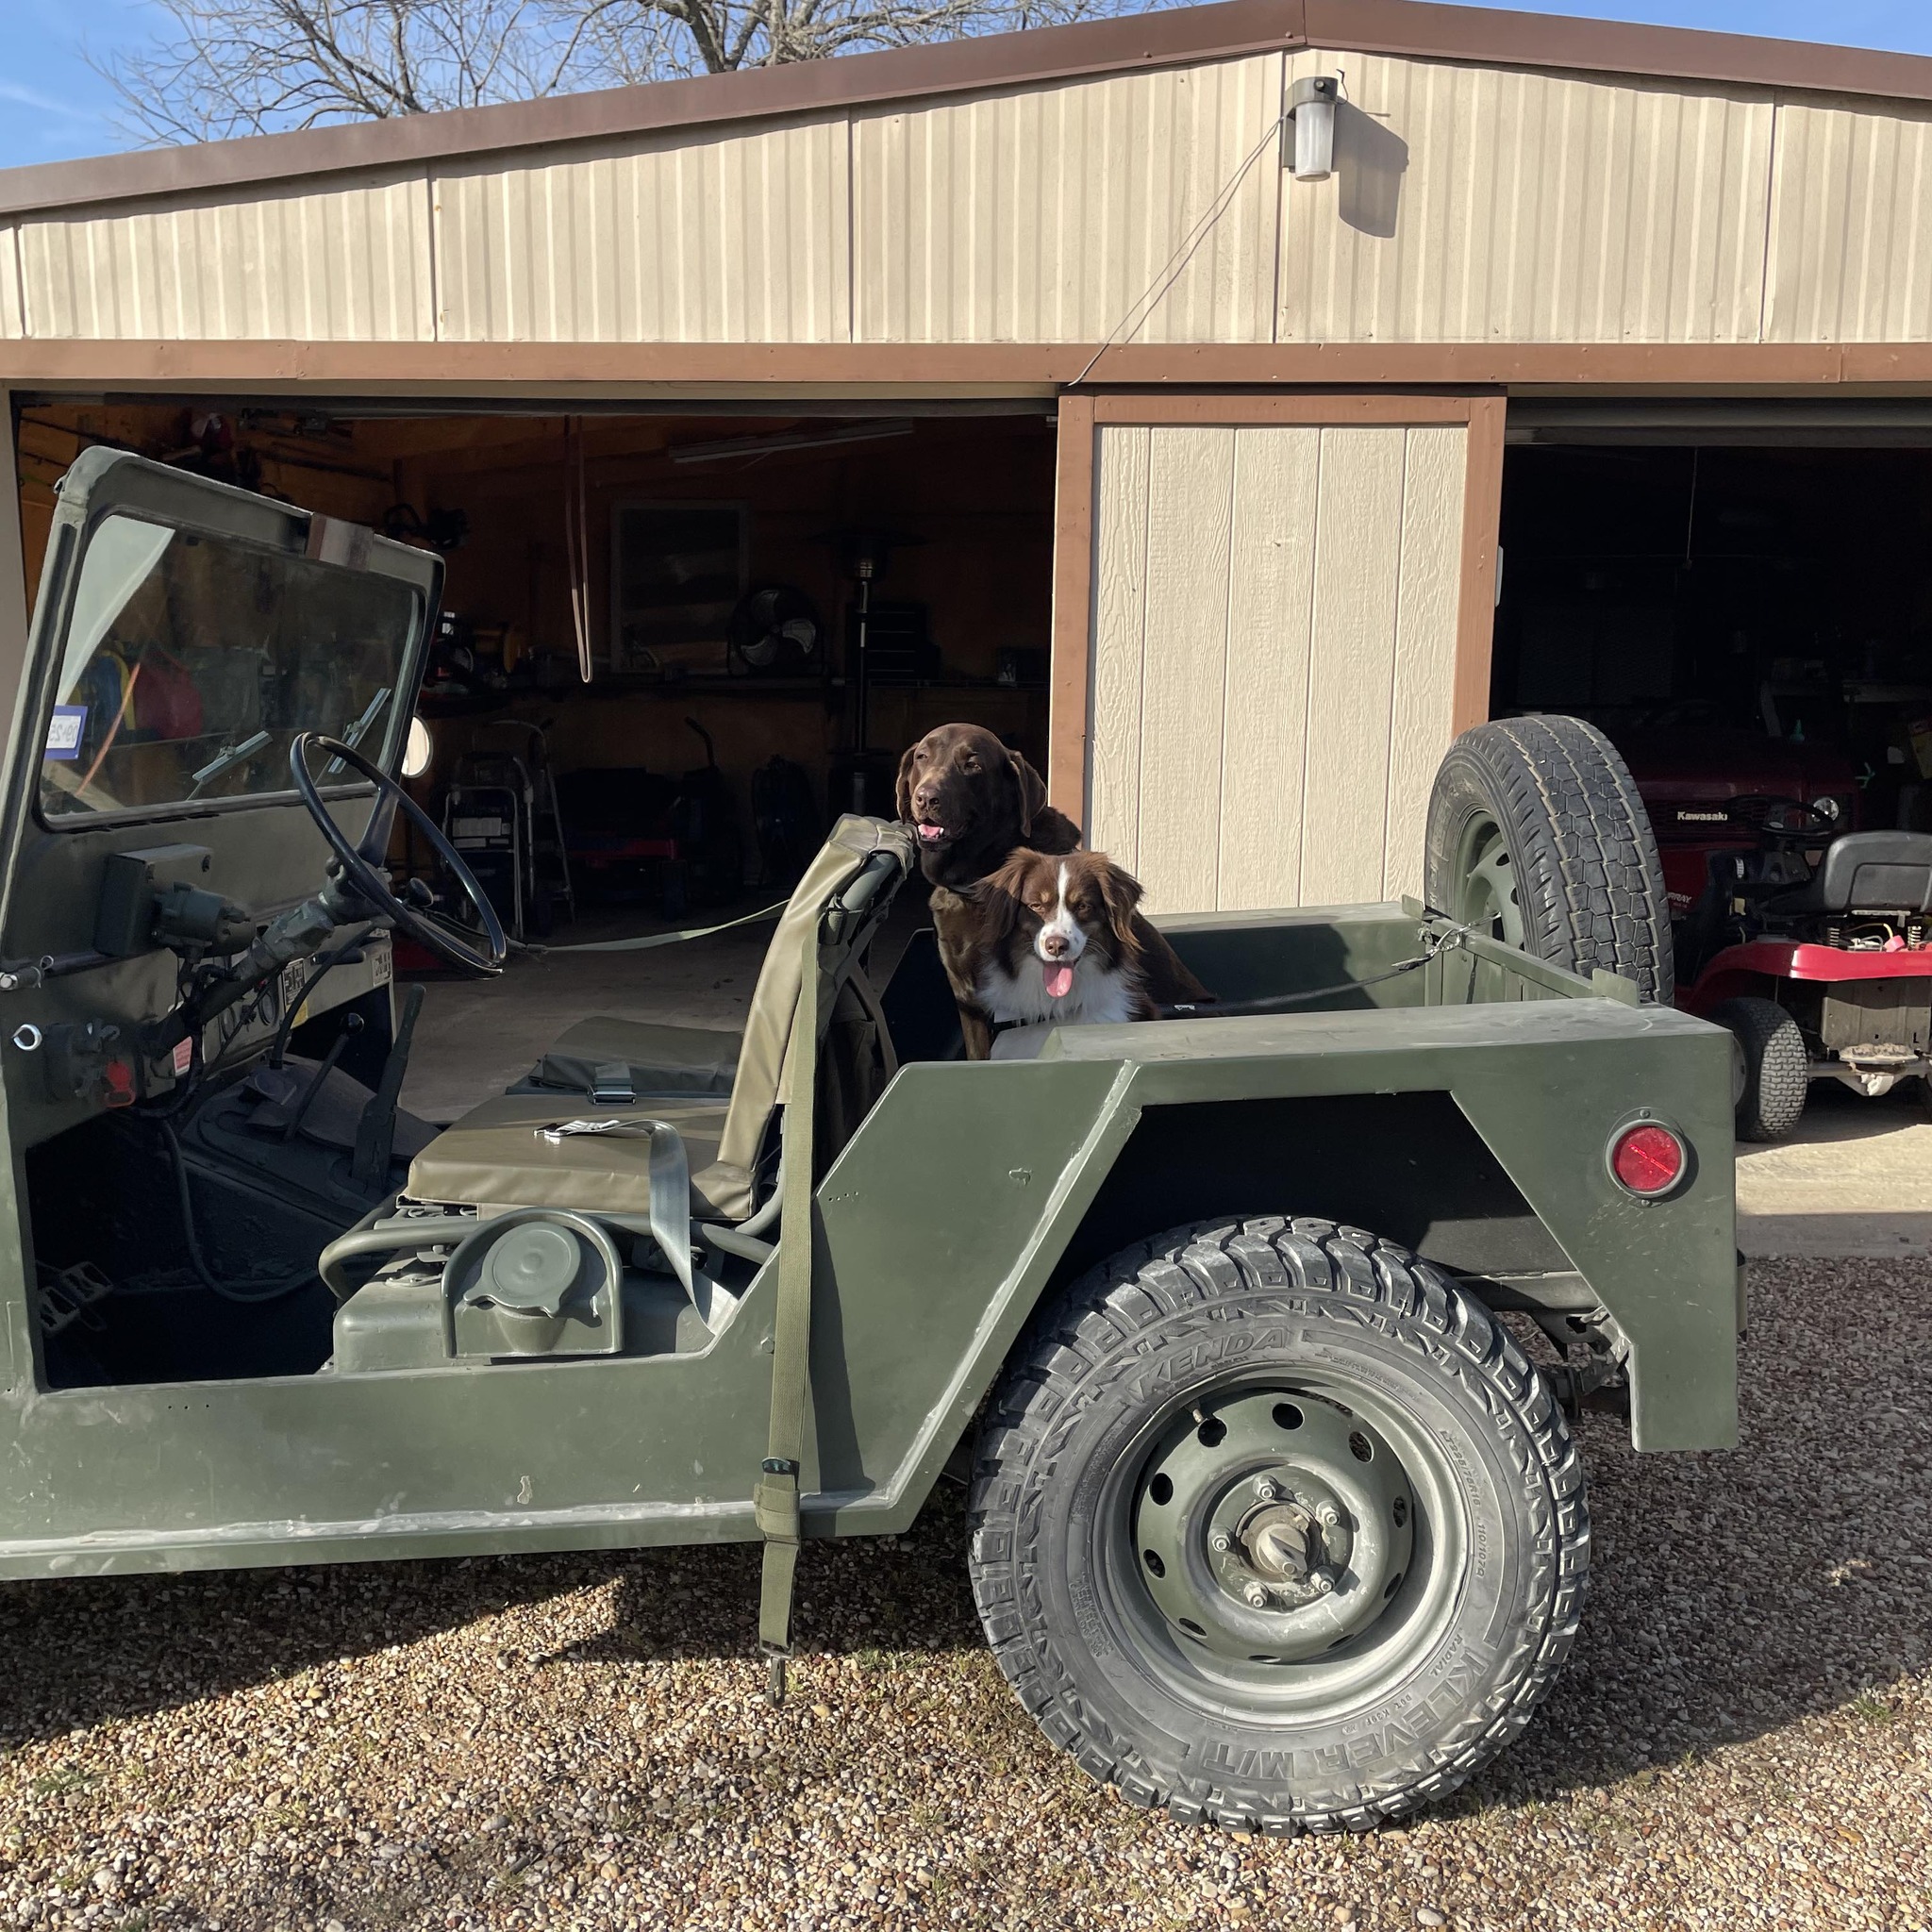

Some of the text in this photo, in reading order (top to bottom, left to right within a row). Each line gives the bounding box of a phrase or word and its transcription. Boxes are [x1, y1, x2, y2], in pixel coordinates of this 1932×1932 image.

[1677, 810, 1728, 822] Kawasaki
[1668, 891, 1692, 903] RRAY
[1135, 1326, 1286, 1400] KENDA
[1430, 1633, 1464, 1677] RADIAL
[1204, 1649, 1489, 1779] KLEVER M/T
